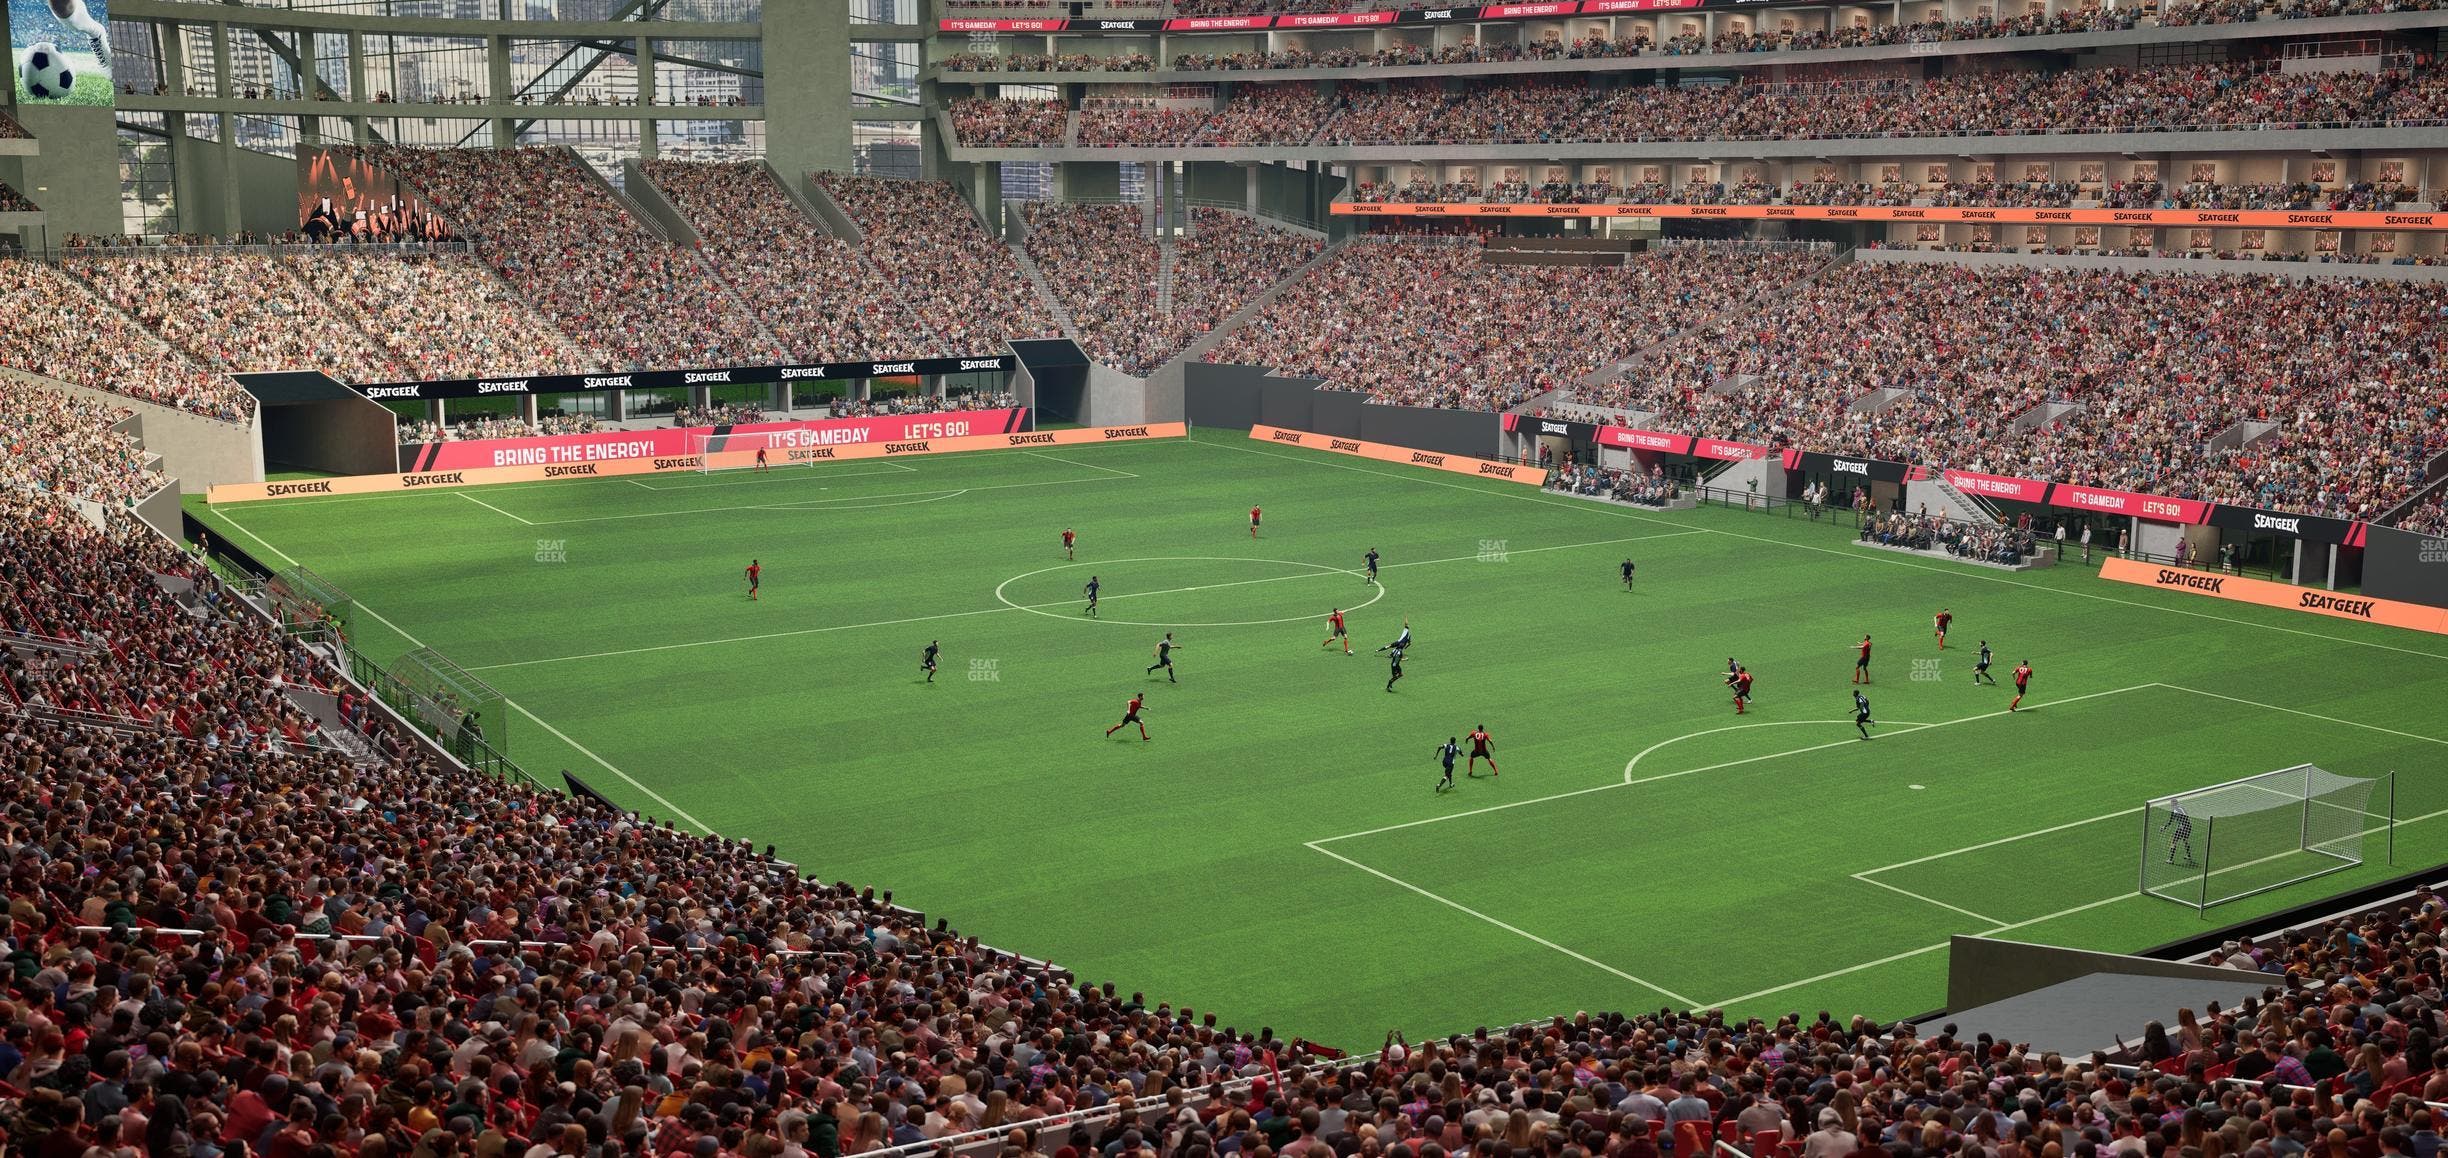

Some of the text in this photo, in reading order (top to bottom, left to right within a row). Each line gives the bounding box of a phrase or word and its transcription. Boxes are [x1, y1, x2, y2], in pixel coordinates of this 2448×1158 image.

[1504, 7, 1521, 15] BRING
[1534, 5, 1557, 13] ENERGY!
[1599, 2, 1610, 10] IT'S
[1611, 1, 1639, 9] GAMEDAY
[1425, 10, 1451, 19] SEATGEEK
[1101, 21, 1134, 29] SEATGEEK
[2036, 212, 2071, 220] SEATGEEK
[2114, 213, 2152, 221] SEATGEEK
[2198, 214, 2239, 223] SEATGEEK
[2288, 215, 2332, 224] SEATGEEK
[2385, 216, 2432, 226] SEATGEEK
[873, 362, 914, 374] SEATGEEK
[960, 358, 1000, 370] SEATGEEK
[684, 371, 730, 383] SEATGEEK
[781, 367, 824, 378] SEATGEEK
[478, 380, 528, 393] SEATGEEK
[584, 375, 632, 389] SEATGEEK
[367, 385, 420, 398] SEATGEEK
[768, 422, 970, 448] IT'S GAMEDAY LET'S GO!
[1104, 426, 1148, 438] SEATGEEK
[1542, 422, 1568, 435] SEATGEEK
[1009, 432, 1055, 445] SEATGEEK
[1273, 430, 1302, 443] SEATGEEK
[1618, 433, 1670, 447] BRING THE ENERGY!
[885, 441, 929, 454] SEATGEEK
[1330, 439, 1361, 454] SEATGEEK
[1712, 445, 1722, 455] IT'S
[494, 441, 654, 466] BRING THE ENERGY!
[788, 447, 835, 461] SEATGEEK
[1411, 452, 1445, 467] SEATGEEK
[654, 456, 704, 470] SEATGEEK
[1834, 458, 1868, 475] SEATGEEK
[545, 464, 596, 477] SEATGEEK
[1479, 462, 1515, 480] SEATGEEK
[403, 472, 463, 487] SEATGEEK
[1954, 476, 2020, 494] BRING THE ENERGY!
[267, 481, 332, 497] SEATGEEK
[2073, 492, 2180, 516] IT'S GAMEDAY LET'S GO!
[2255, 514, 2299, 533] SEATGEEK
[2157, 570, 2224, 593] SEATGEEK
[2300, 592, 2376, 618] SEATGEEK
